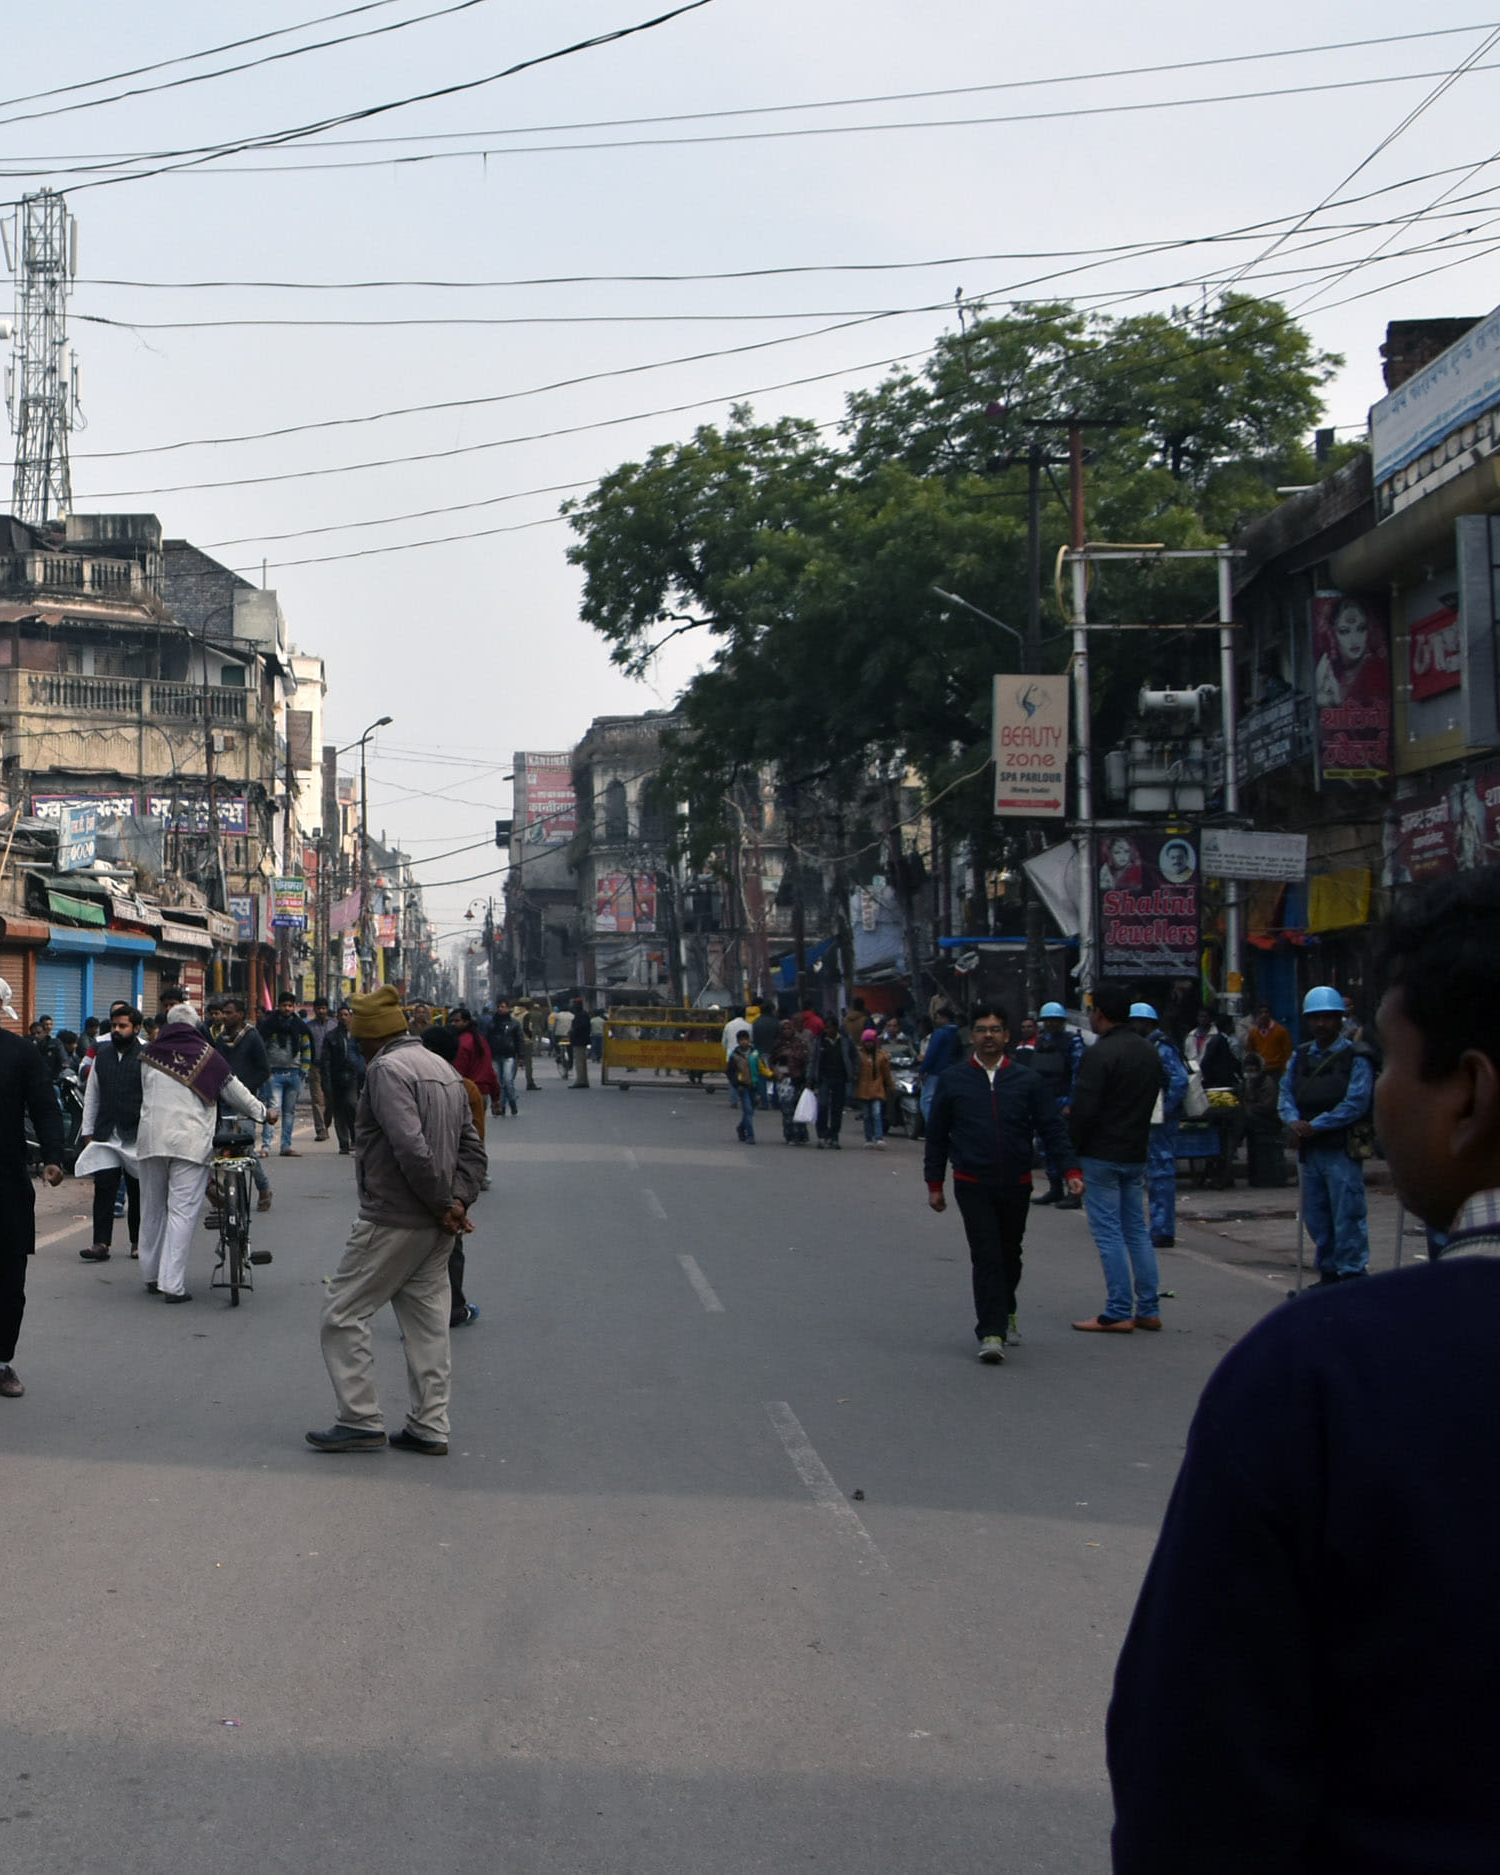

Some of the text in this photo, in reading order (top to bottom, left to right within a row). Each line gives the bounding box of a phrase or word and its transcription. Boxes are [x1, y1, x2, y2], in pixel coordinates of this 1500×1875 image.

[1001, 725, 1062, 748] BEAUTY
[1006, 753, 1056, 767] zone
[1000, 772, 1062, 783] SPA PARLOUR
[1102, 888, 1197, 916] Shalini
[1105, 919, 1198, 945] Jewellers
